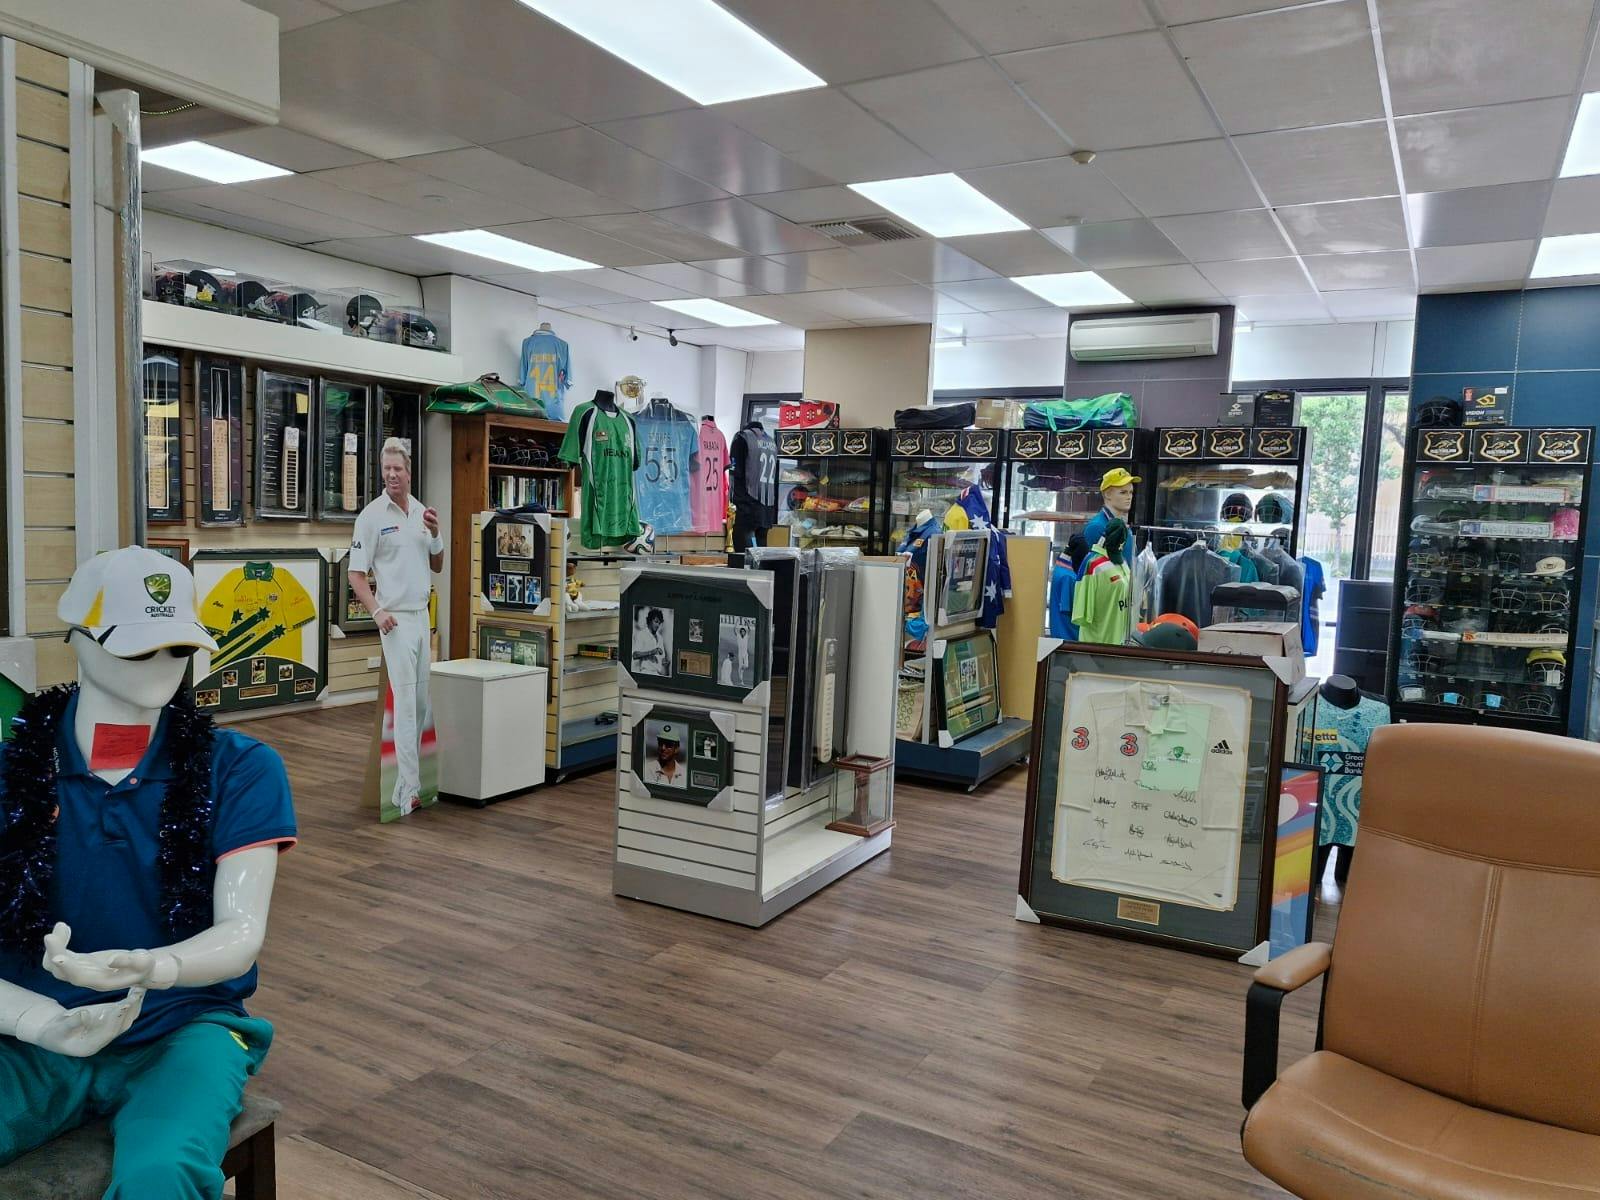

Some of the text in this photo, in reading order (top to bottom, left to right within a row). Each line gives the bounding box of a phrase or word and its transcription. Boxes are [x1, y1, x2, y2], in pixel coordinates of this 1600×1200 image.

[529, 366, 557, 399] 14
[705, 457, 719, 491] 25
[760, 453, 776, 484] 22
[145, 606, 176, 614] CRICKET
[1071, 726, 1090, 751] 3
[1120, 732, 1139, 757] 3
